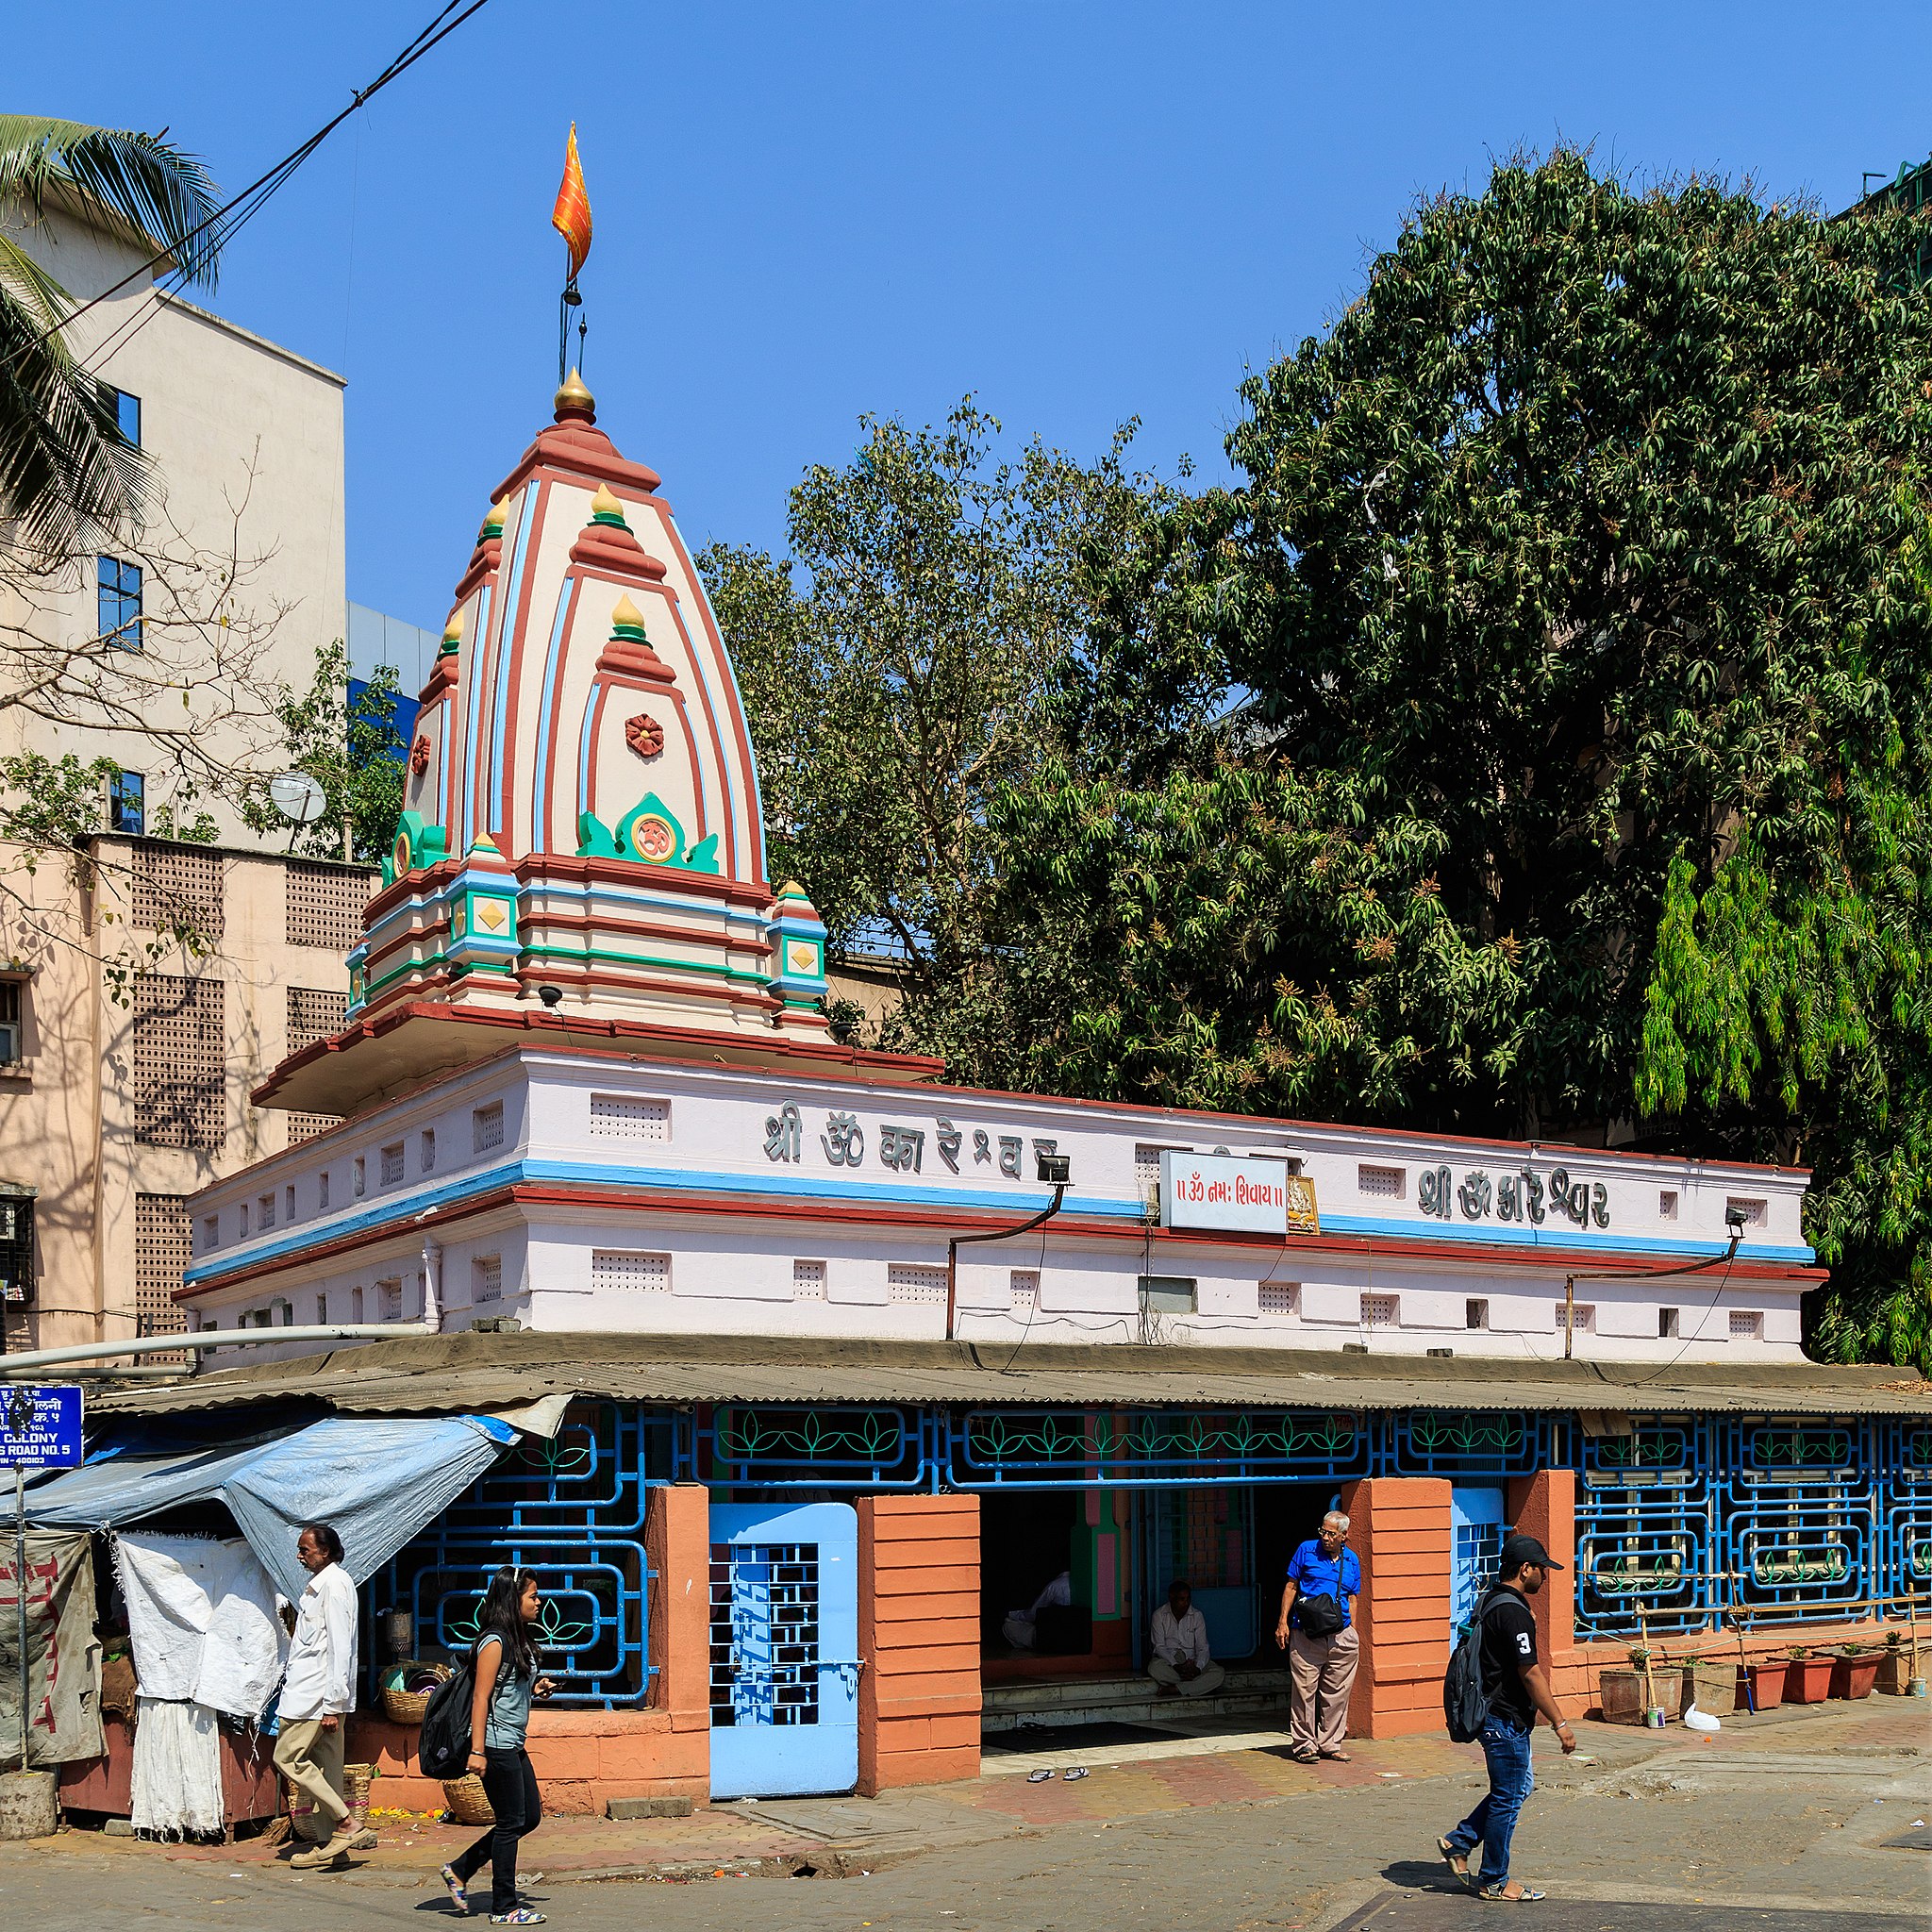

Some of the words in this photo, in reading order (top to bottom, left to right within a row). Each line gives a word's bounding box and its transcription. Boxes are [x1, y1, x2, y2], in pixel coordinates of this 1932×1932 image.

[762, 1099, 802, 1163] श्री
[1235, 1174, 1272, 1207] શિવાય
[8, 1445, 39, 1455] ROAD
[41, 1445, 60, 1455] NO.
[61, 1444, 71, 1455] 5
[1516, 1632, 1531, 1654] 3
